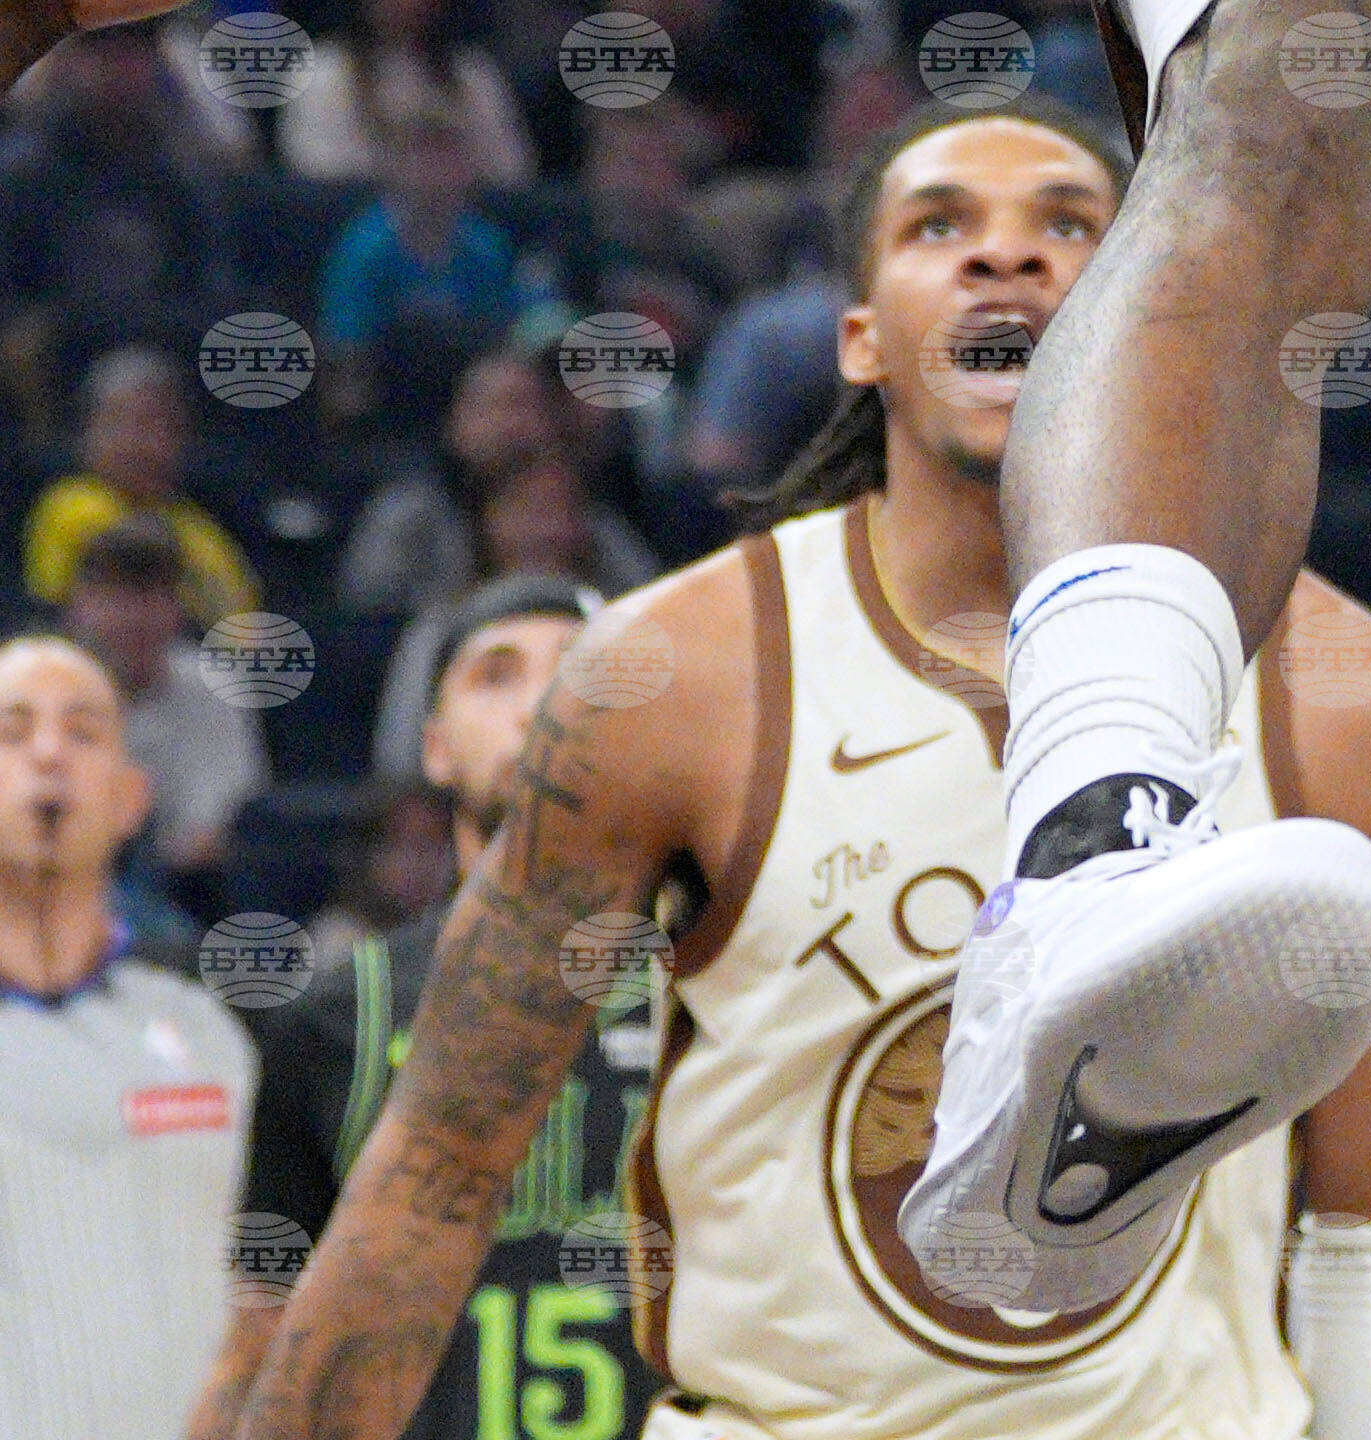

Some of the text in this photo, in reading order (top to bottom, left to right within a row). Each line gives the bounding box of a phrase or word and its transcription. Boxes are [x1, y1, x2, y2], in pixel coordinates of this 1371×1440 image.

[793, 865, 986, 1007] TO
[808, 839, 891, 911] The
[468, 1284, 627, 1440] 15
